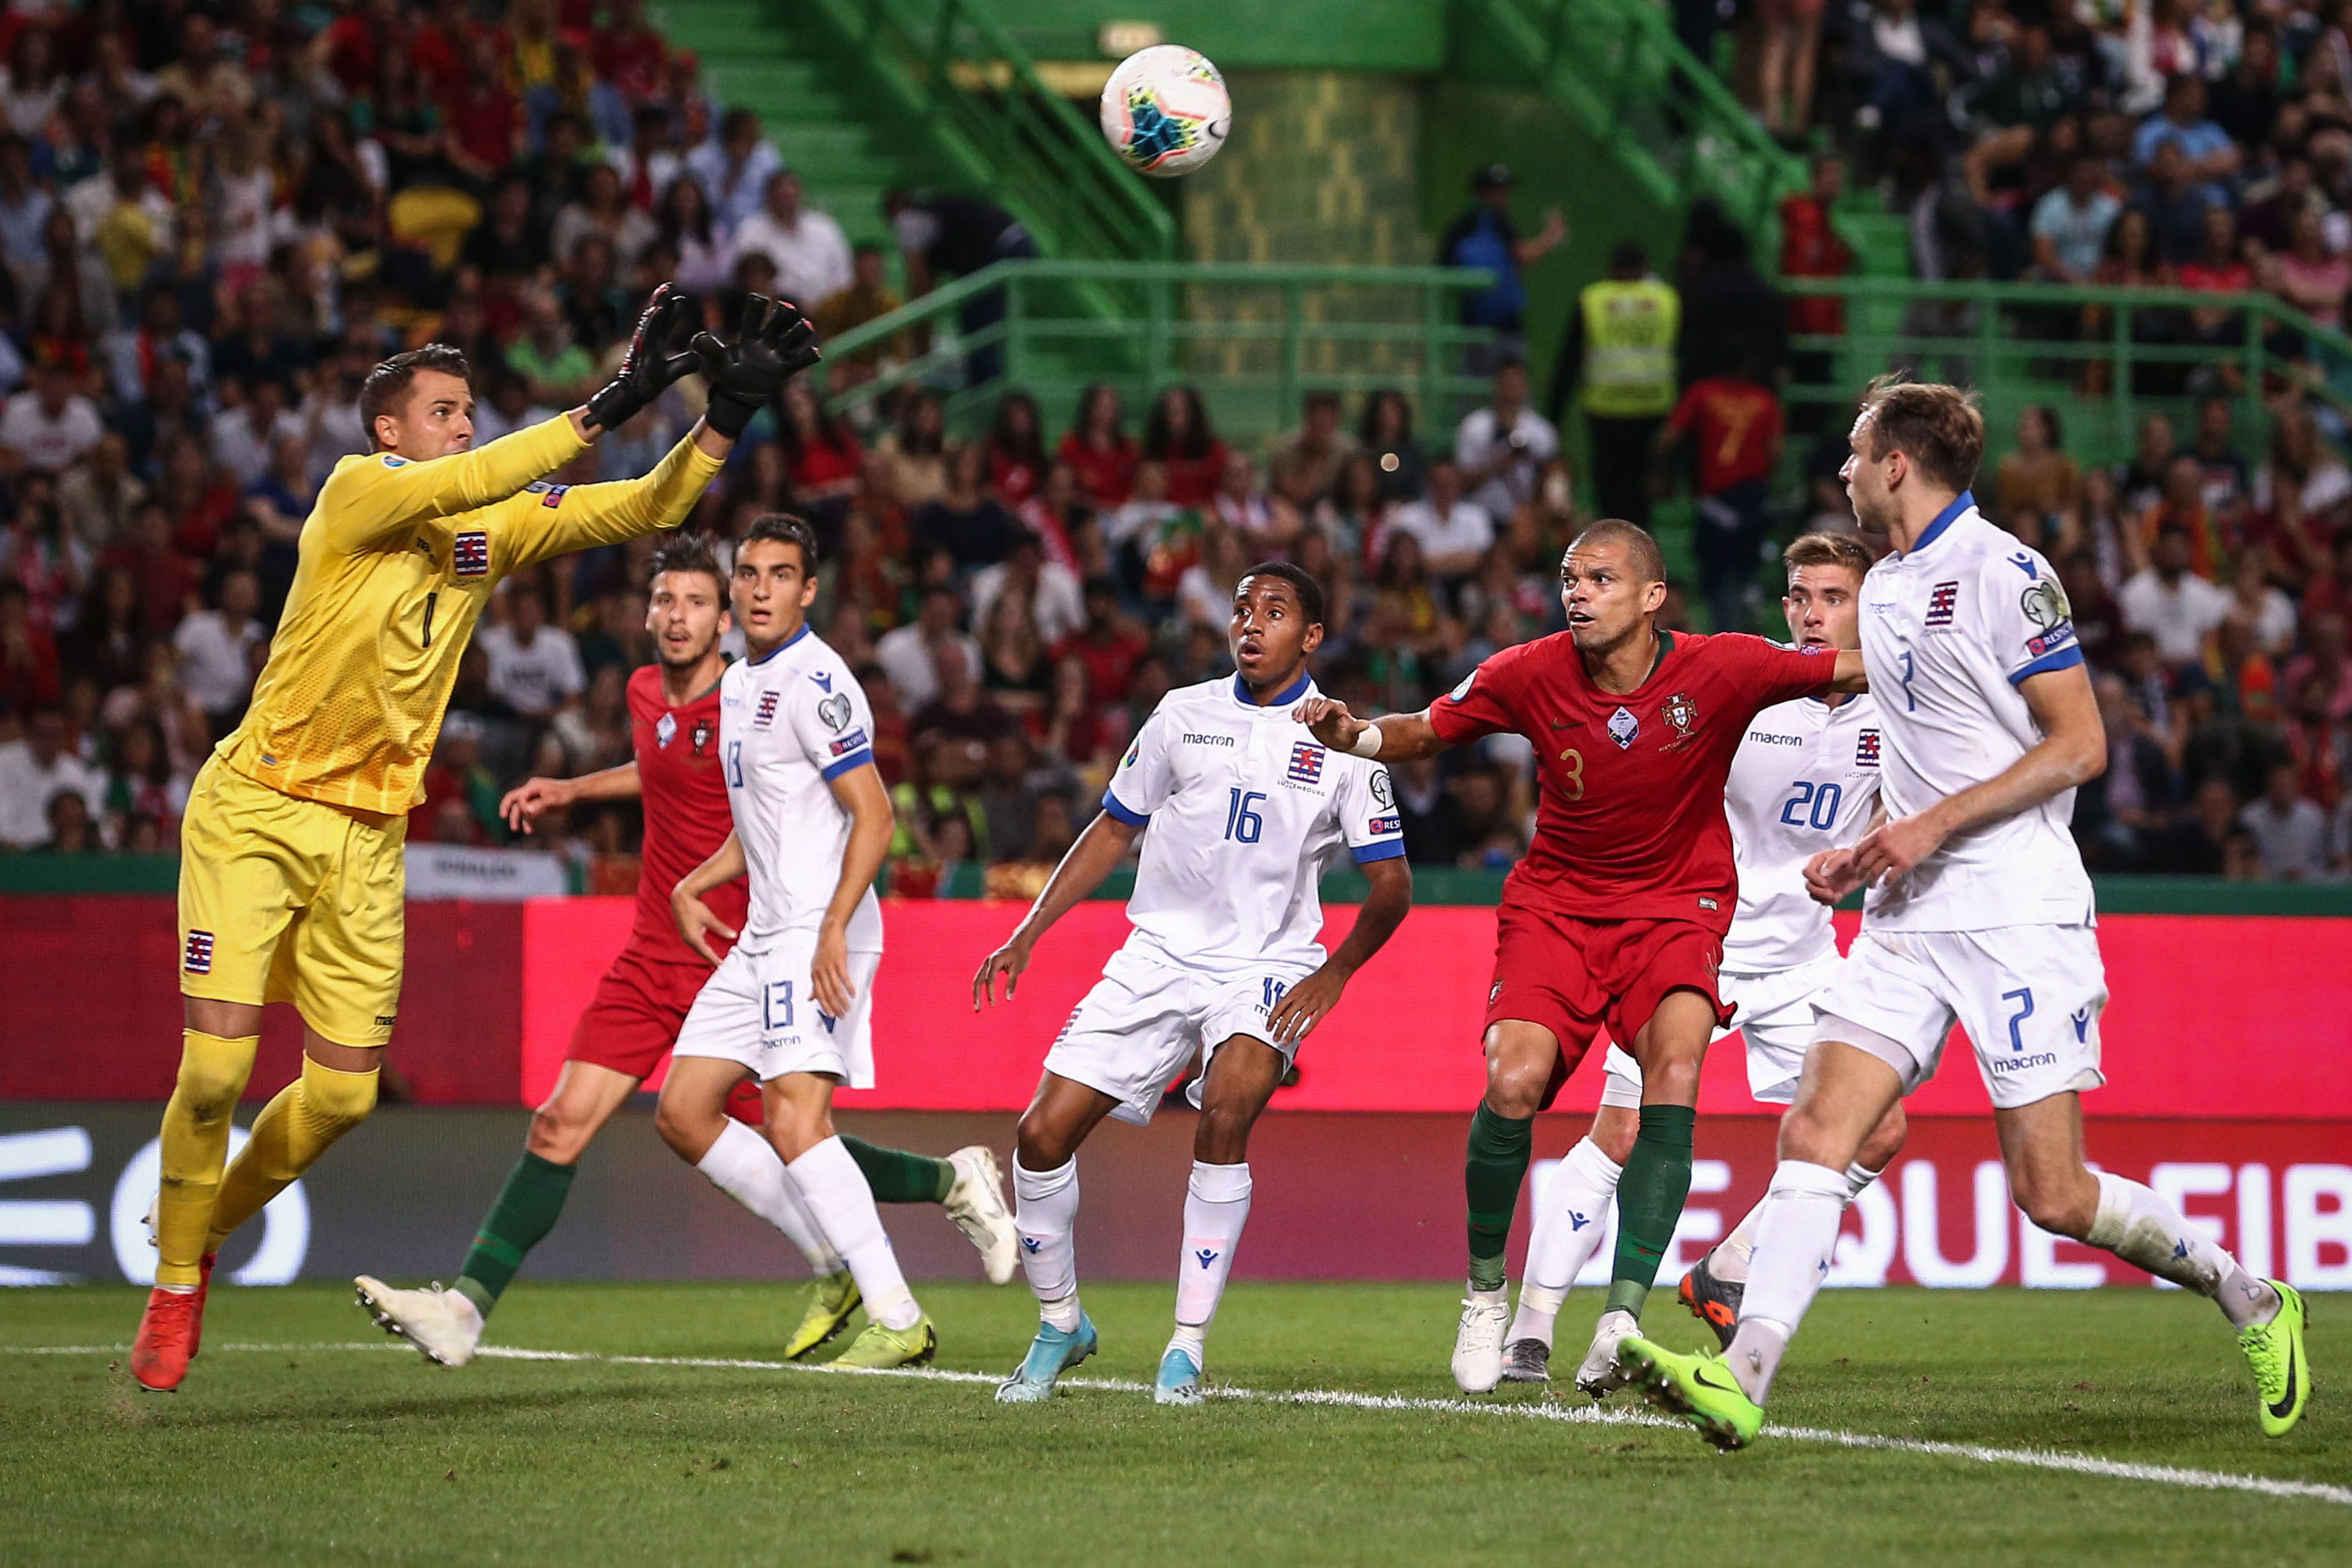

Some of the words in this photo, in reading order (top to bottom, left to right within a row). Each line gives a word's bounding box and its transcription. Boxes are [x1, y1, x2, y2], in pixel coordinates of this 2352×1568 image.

[421, 592, 437, 648] 1
[1899, 650, 1915, 711] 7
[1182, 732, 1235, 748] macron
[1750, 731, 1803, 747] macron
[1277, 779, 1326, 797] LUXEMBOURG
[1560, 749, 1584, 801] 3
[1224, 787, 1267, 844] 16
[1780, 781, 1842, 831] 20
[763, 980, 794, 1031] 13
[2002, 987, 2035, 1052] 7
[1994, 1052, 2056, 1073] macron
